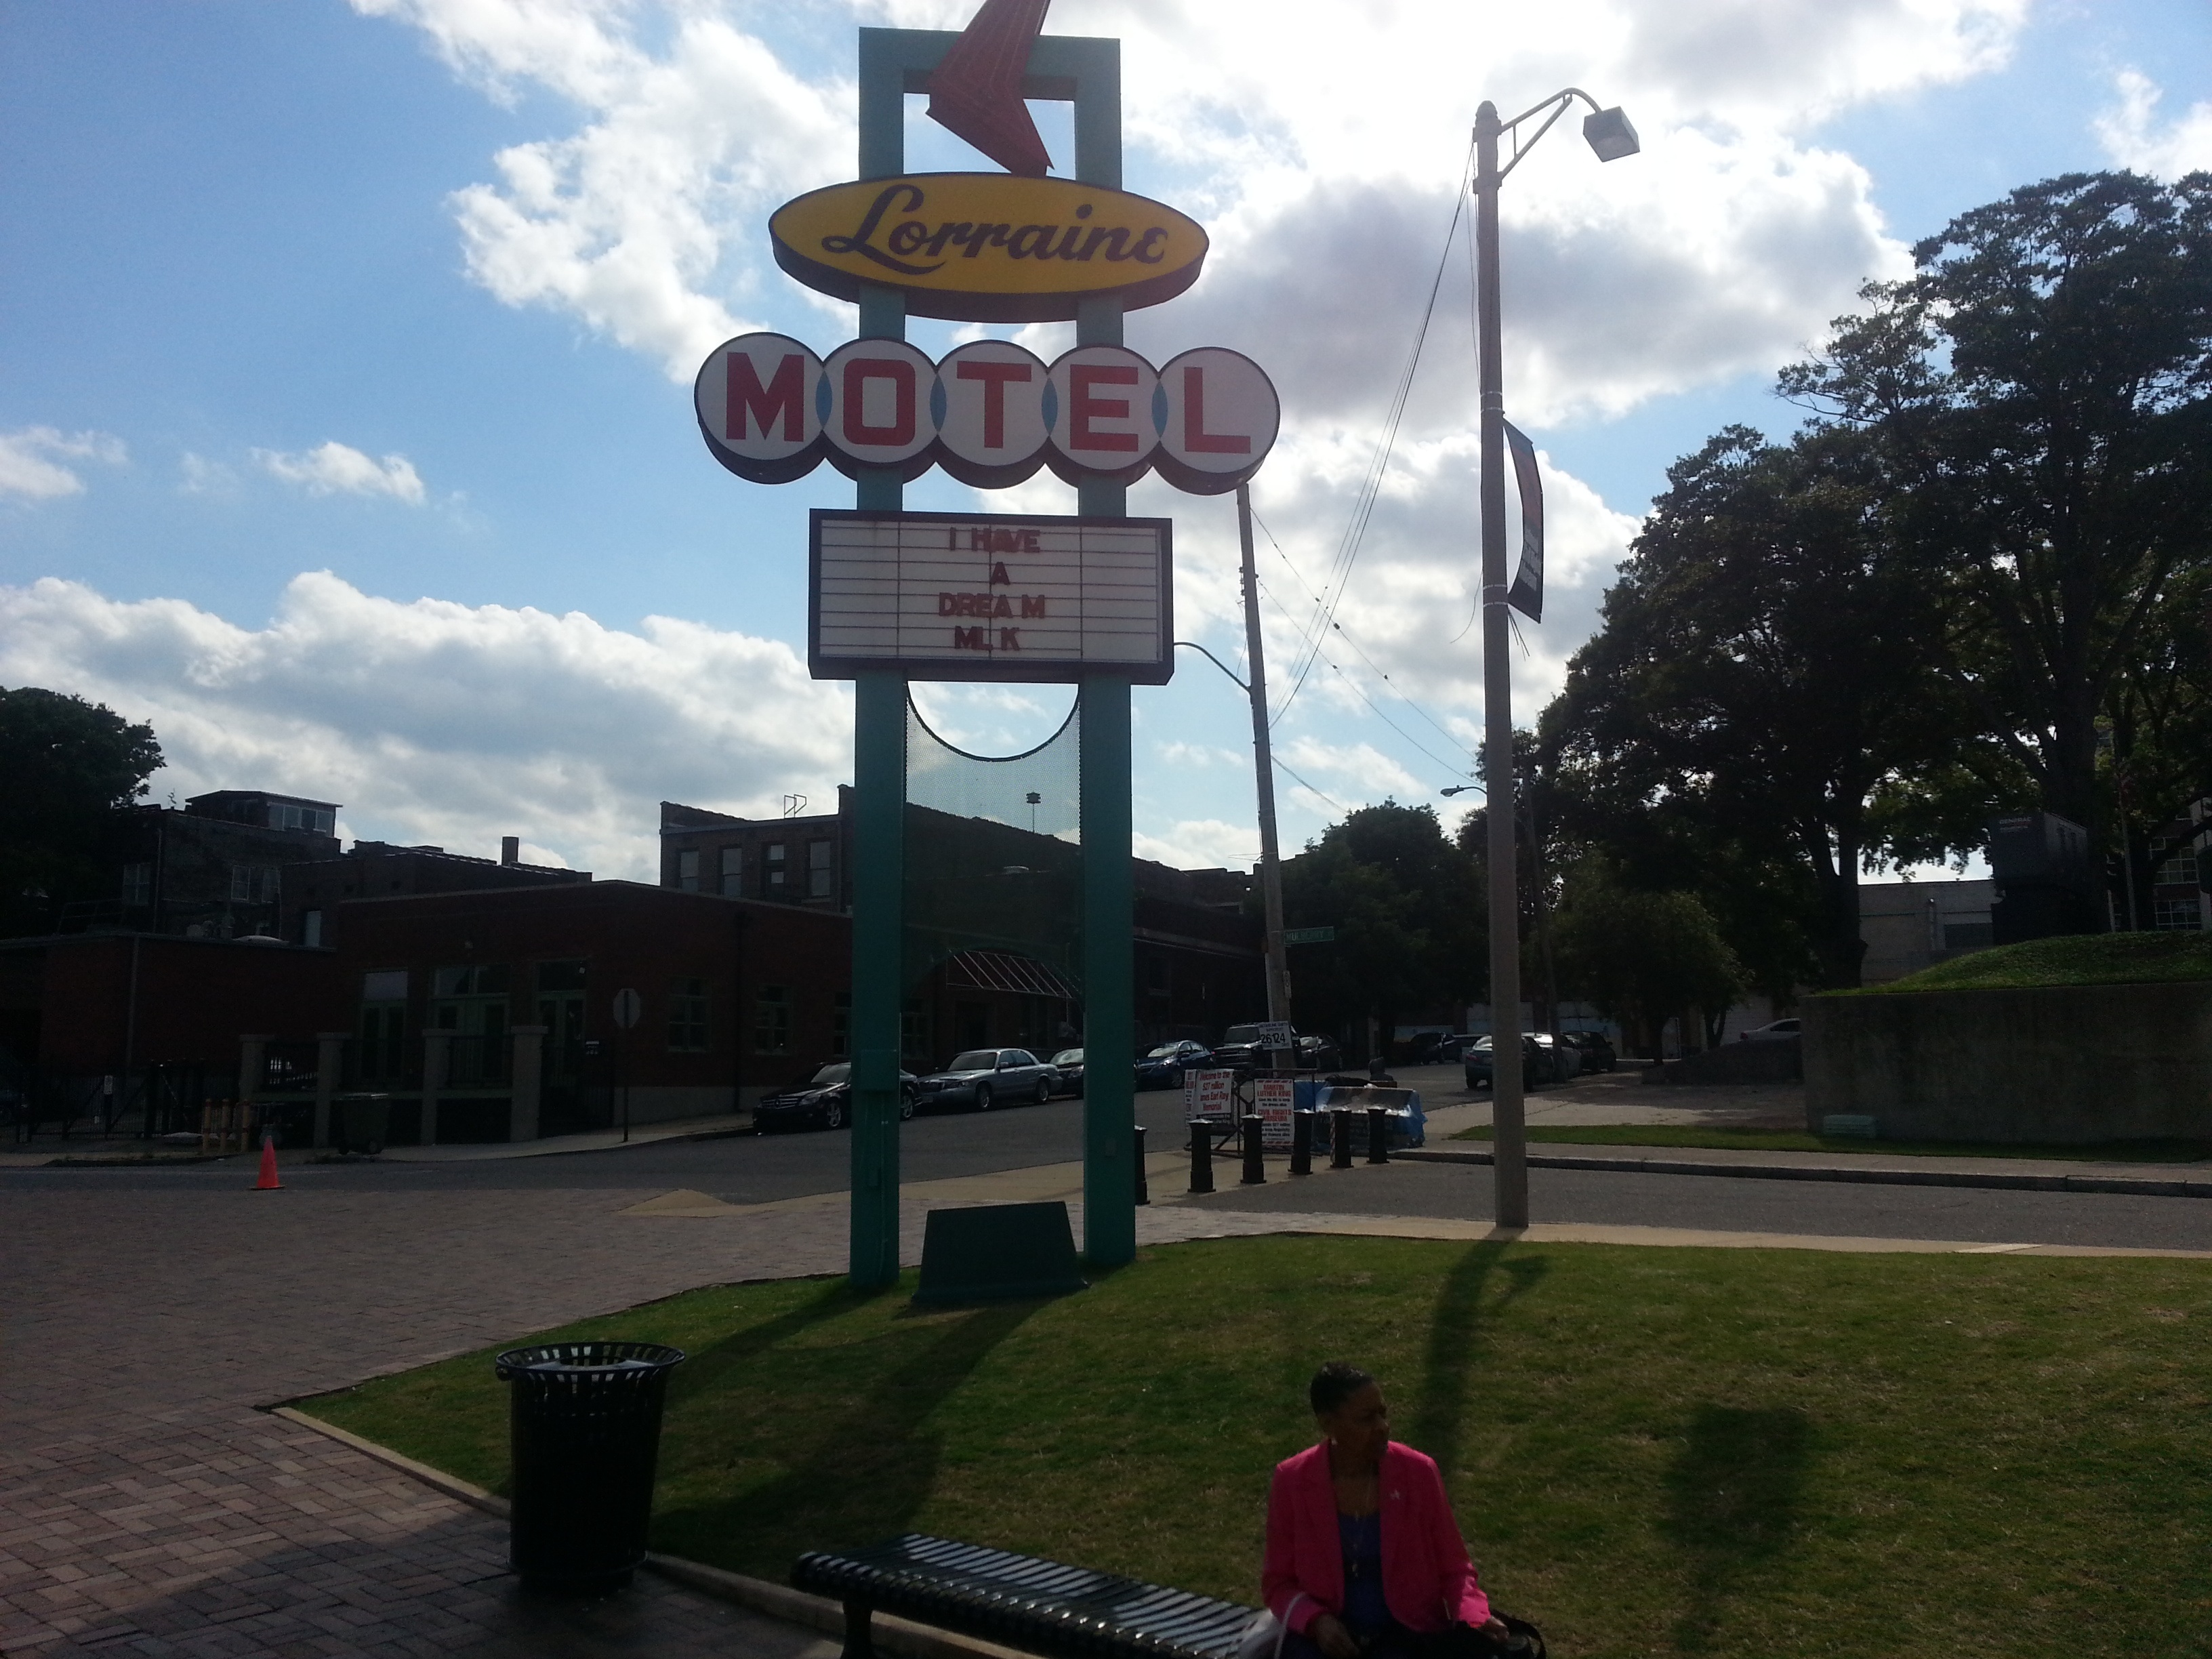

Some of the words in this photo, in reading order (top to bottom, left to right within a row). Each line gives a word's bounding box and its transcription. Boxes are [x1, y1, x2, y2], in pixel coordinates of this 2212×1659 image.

[822, 184, 1168, 274] Lorraine
[725, 352, 1252, 455] MOTEL
[949, 527, 956, 552] I
[971, 527, 1041, 553] HAVE
[990, 561, 1011, 586] A
[939, 592, 1045, 619] DREAM
[954, 626, 1021, 651] MLK
